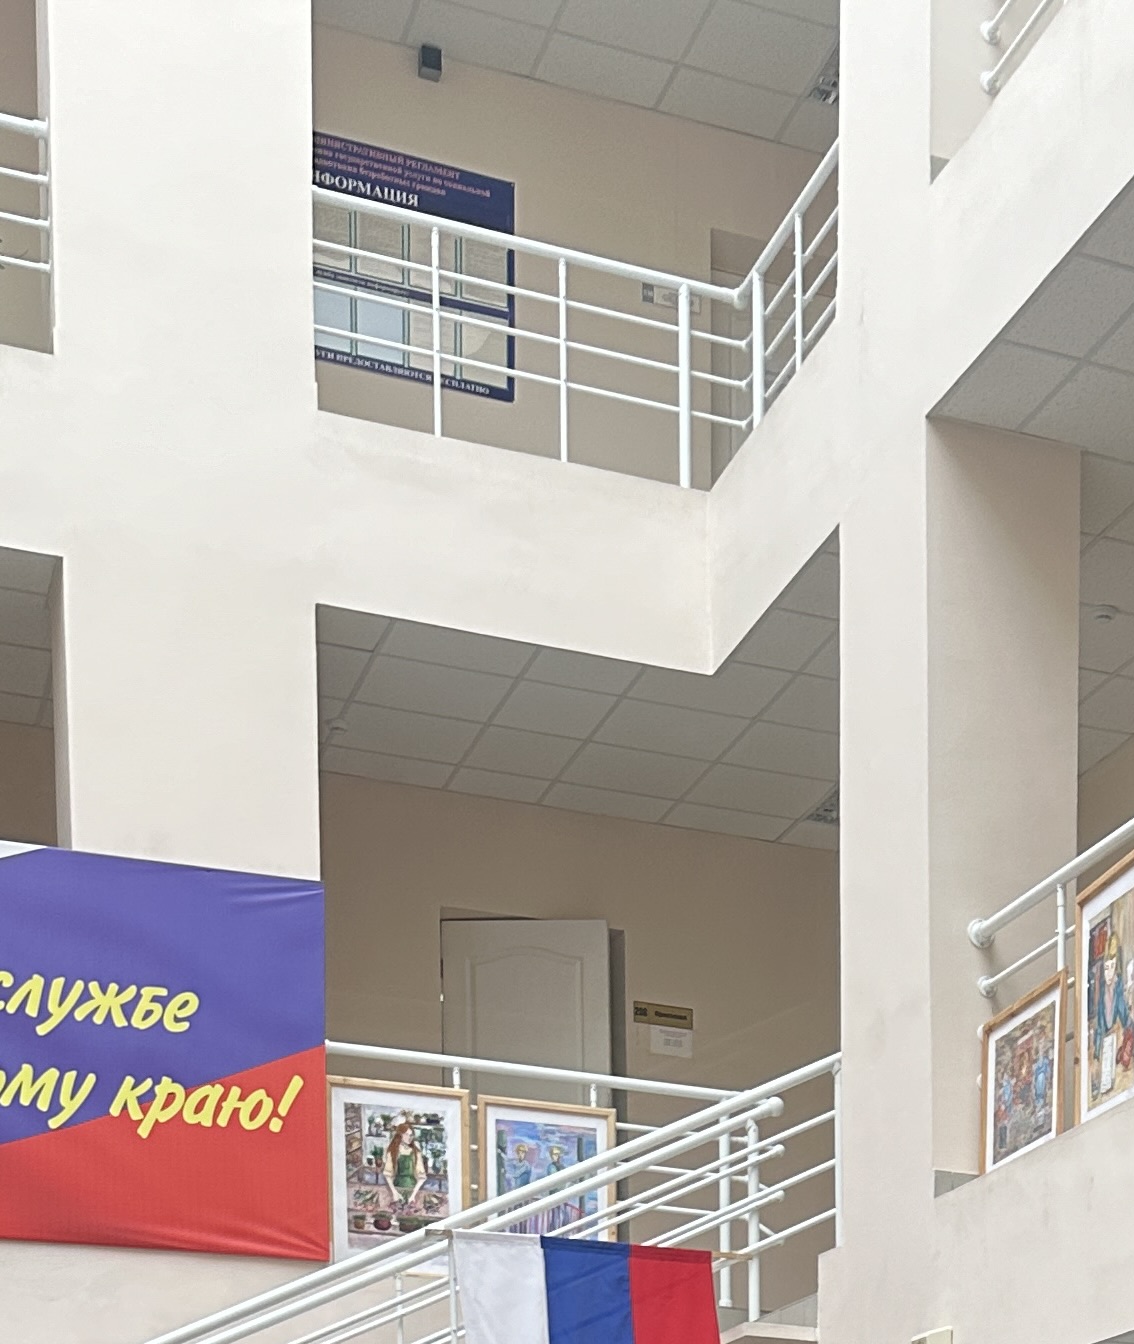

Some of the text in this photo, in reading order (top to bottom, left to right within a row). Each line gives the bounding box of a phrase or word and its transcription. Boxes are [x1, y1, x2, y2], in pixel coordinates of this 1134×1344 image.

[0, 970, 200, 1036] службе
[0, 1063, 304, 1139] му краю!
